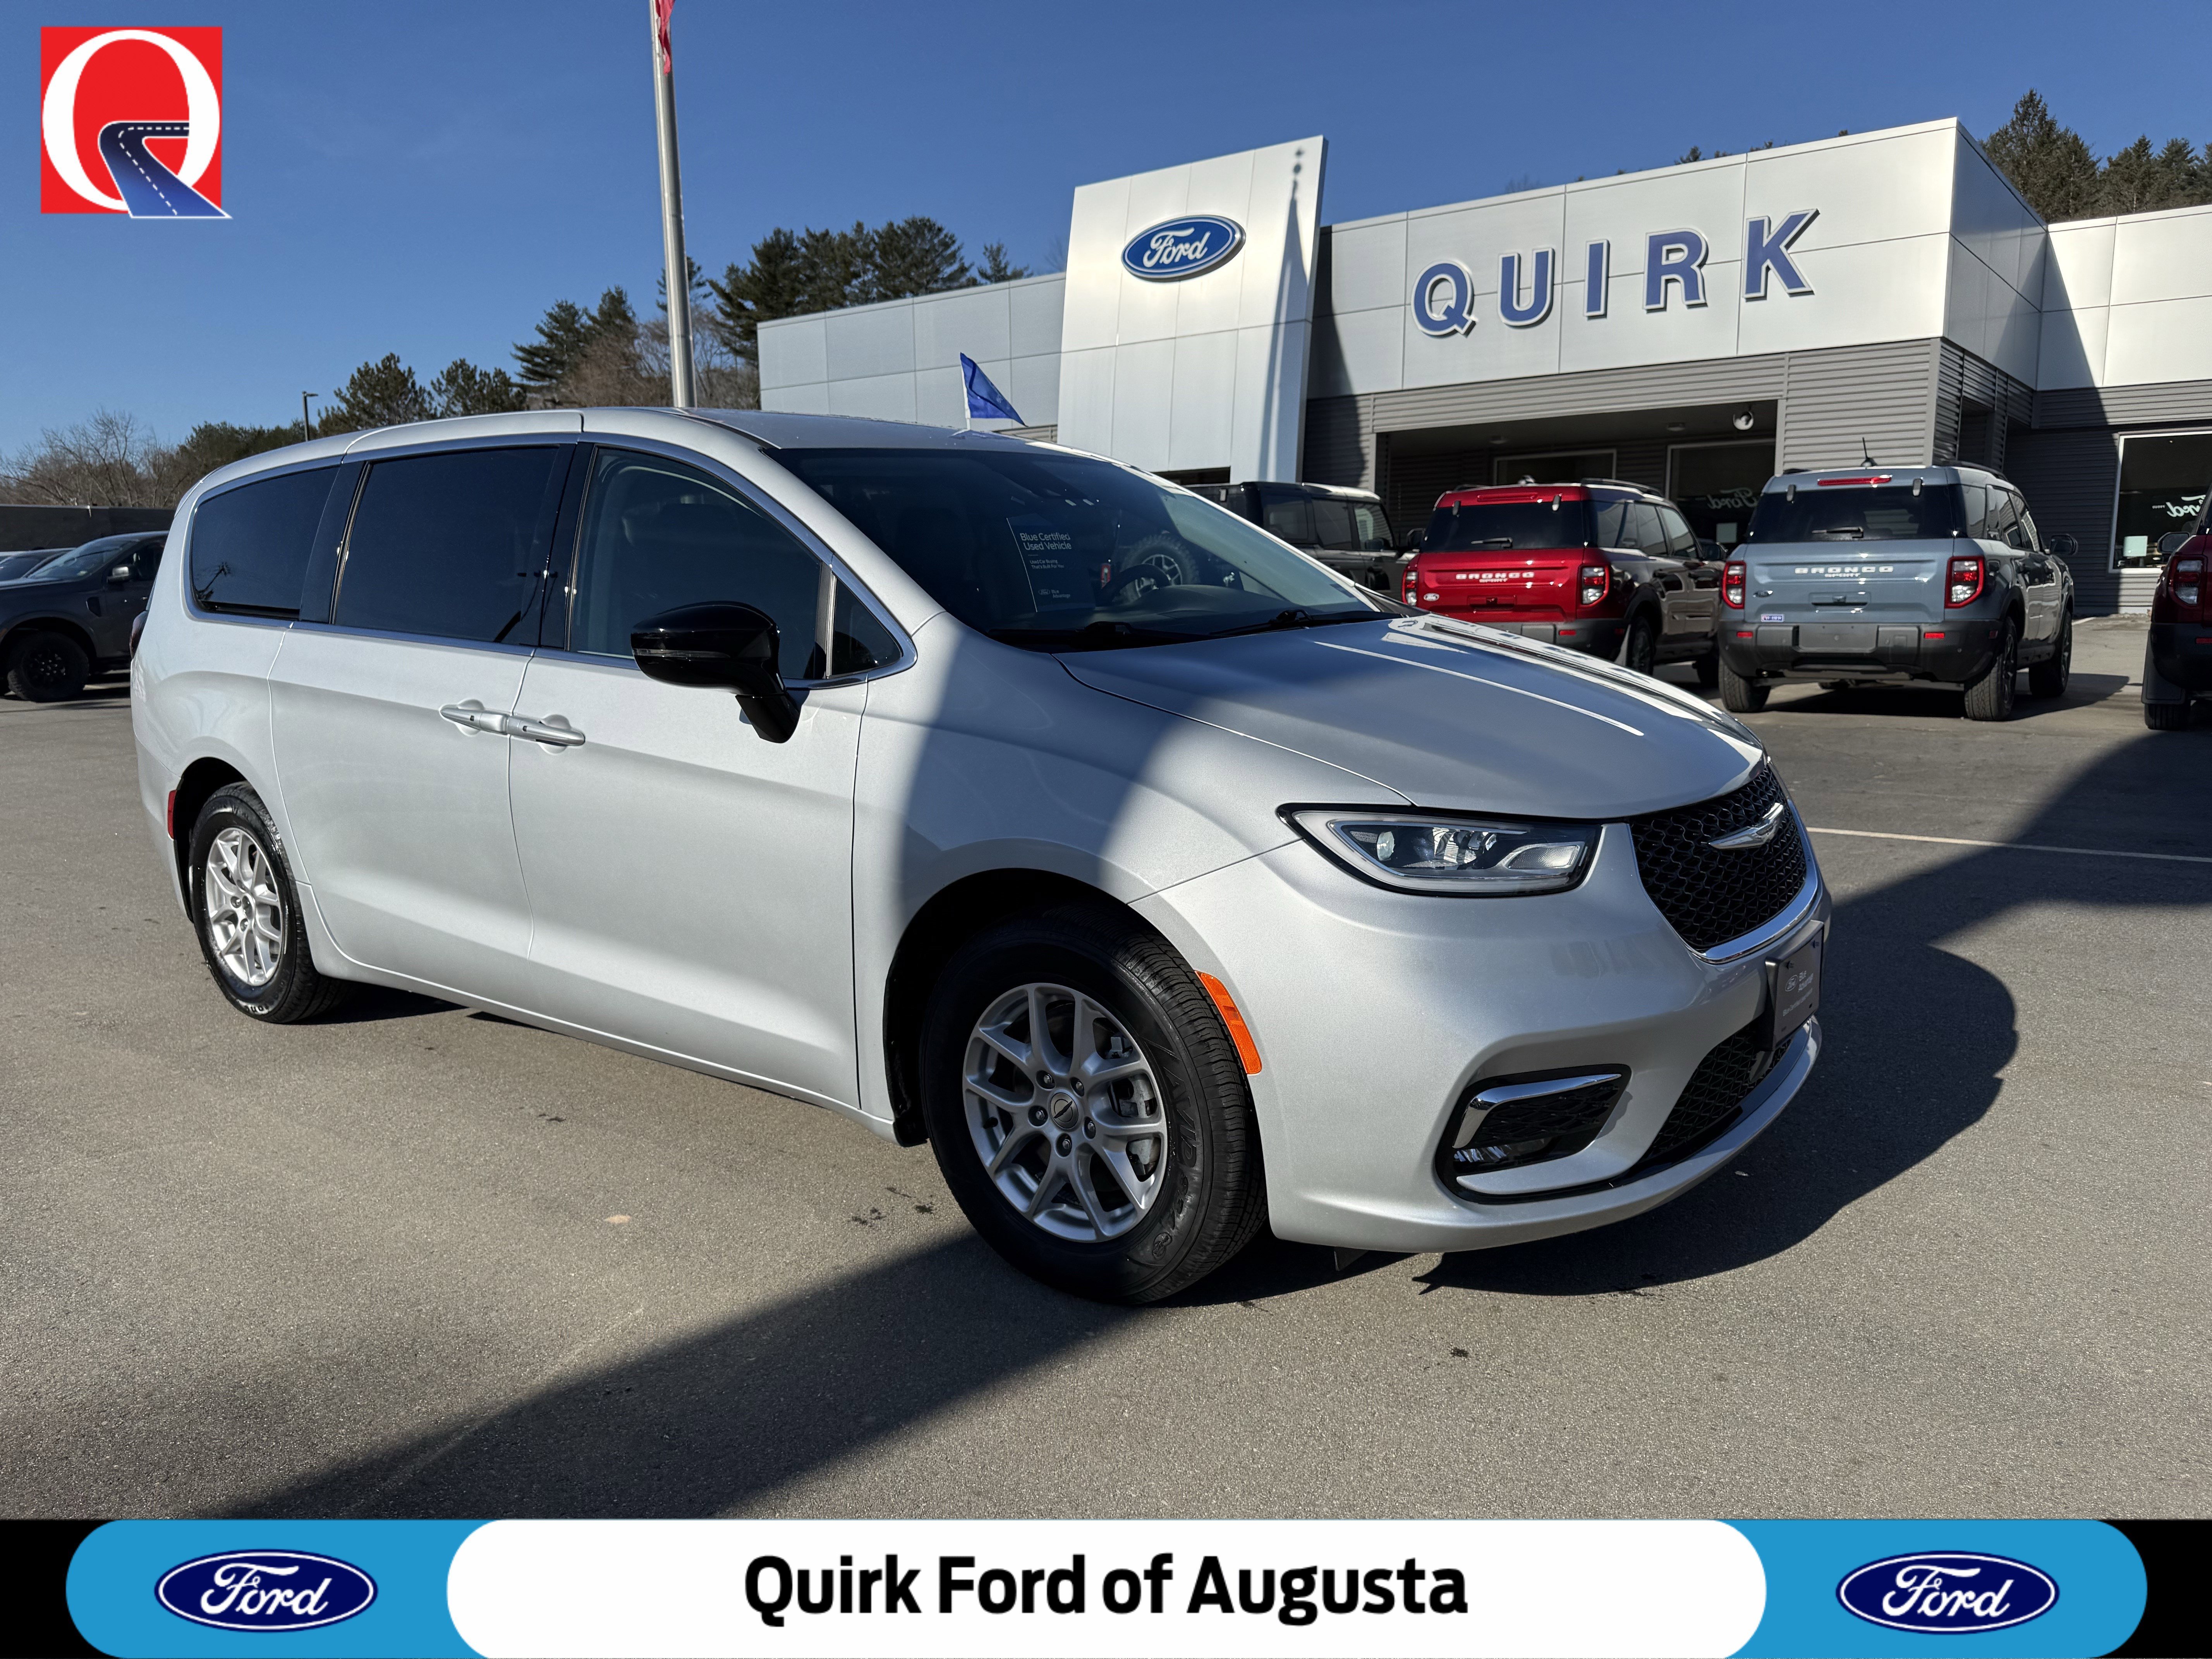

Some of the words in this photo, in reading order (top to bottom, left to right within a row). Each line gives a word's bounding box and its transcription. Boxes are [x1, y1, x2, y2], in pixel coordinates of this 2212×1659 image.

[1143, 227, 1211, 268] Ford
[1410, 208, 1819, 338] QUIRK
[1020, 533, 1038, 541] Blue
[1038, 532, 1071, 541] Certified
[1023, 542, 1044, 550] Used
[1044, 541, 1072, 550] Vehicle
